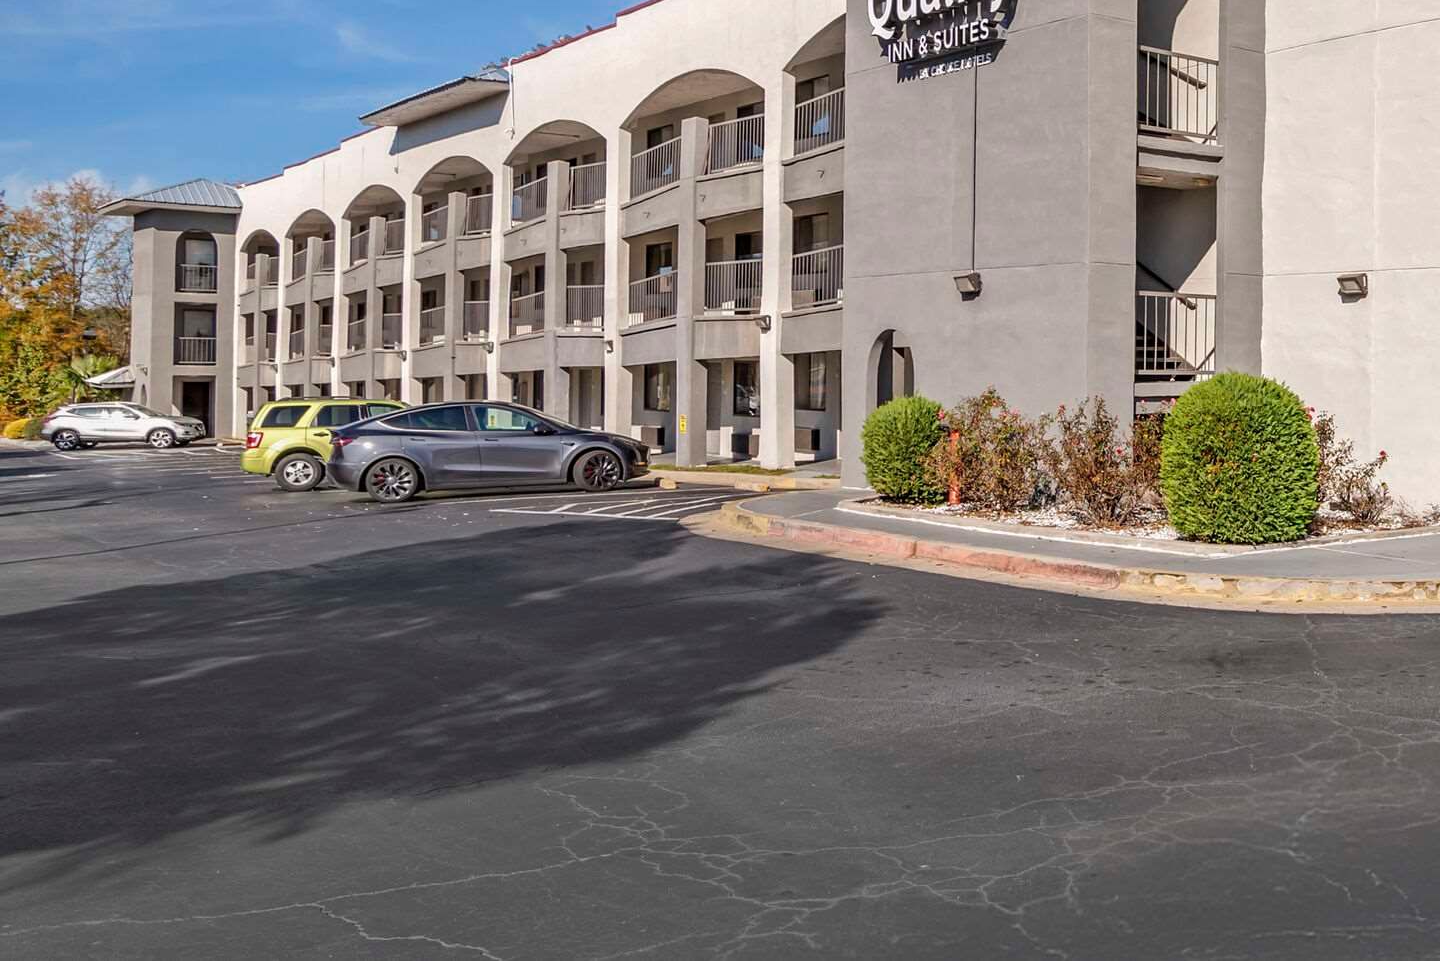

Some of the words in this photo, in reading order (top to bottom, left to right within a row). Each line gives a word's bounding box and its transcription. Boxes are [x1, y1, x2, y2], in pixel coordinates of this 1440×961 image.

[888, 38, 914, 63] INN
[918, 35, 929, 56] &
[933, 18, 989, 51] SUITES
